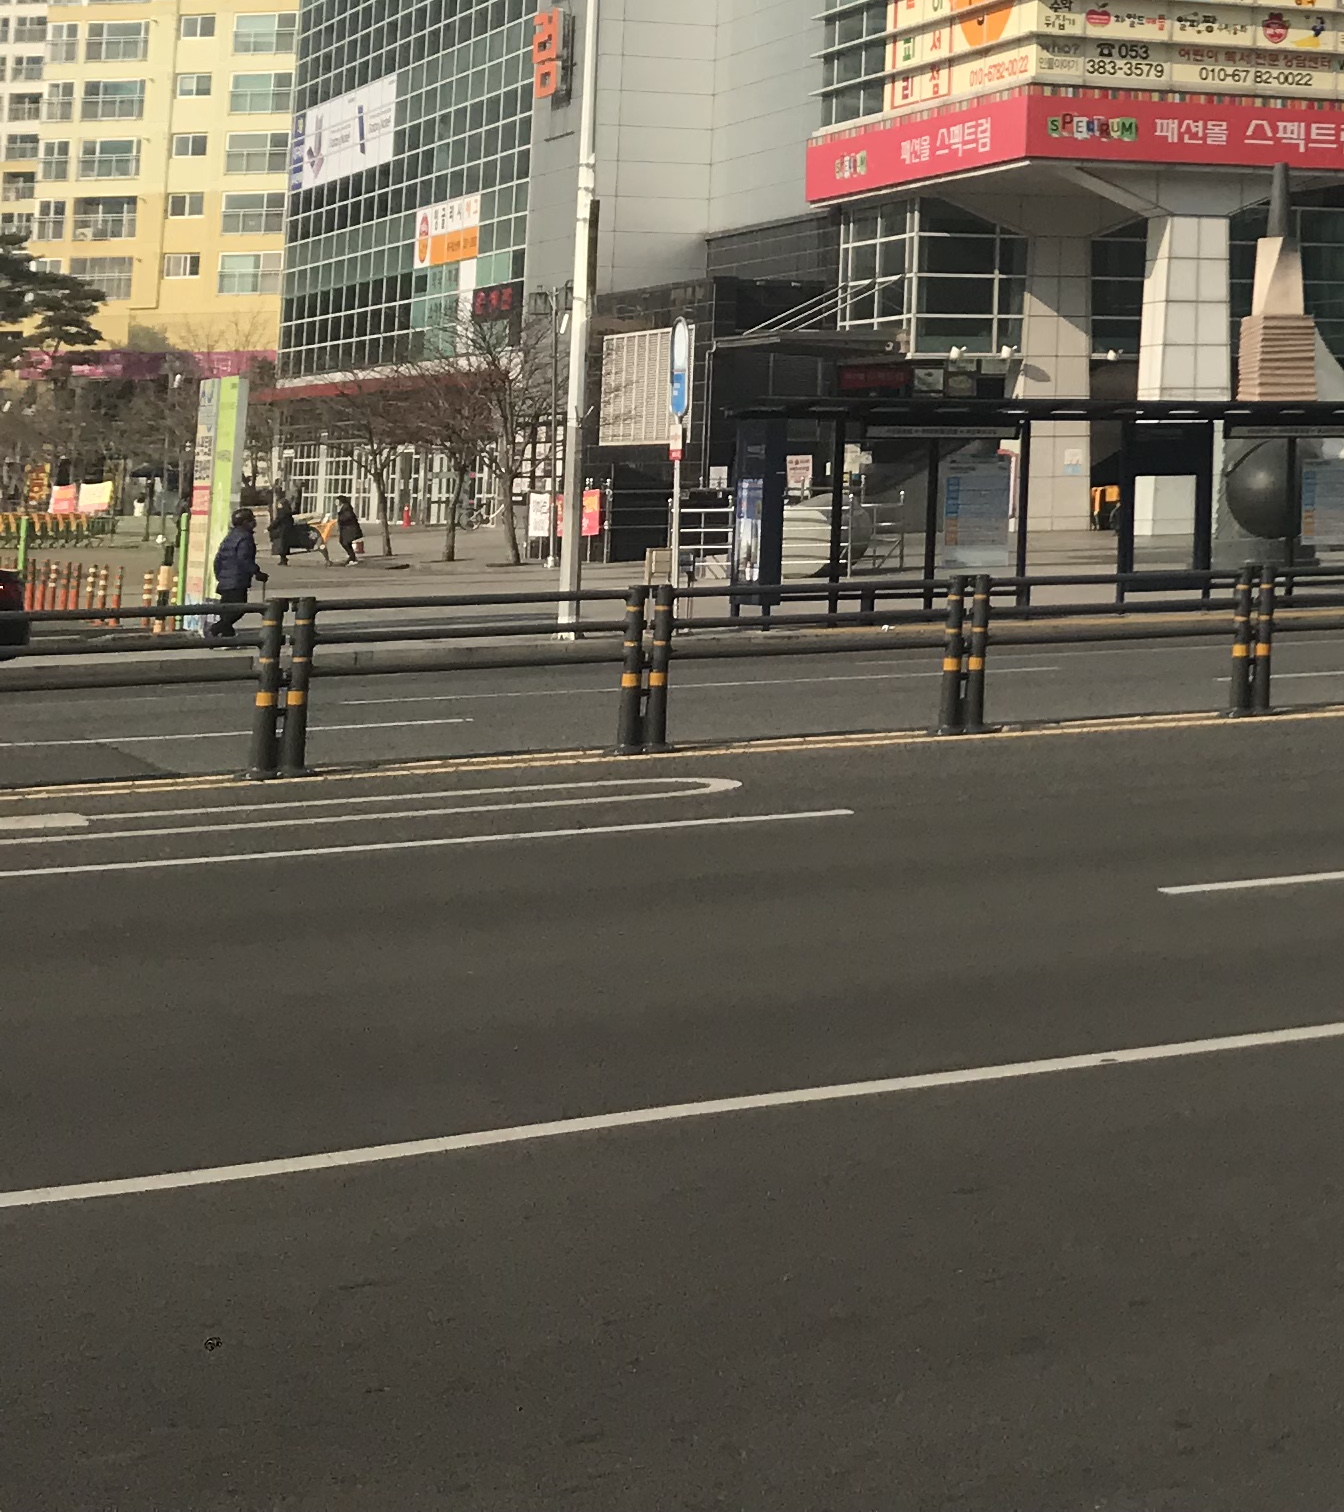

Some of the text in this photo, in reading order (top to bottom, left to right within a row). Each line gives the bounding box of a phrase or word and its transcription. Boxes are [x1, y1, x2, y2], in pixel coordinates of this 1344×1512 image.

[1118, 42, 1150, 59] 053
[1086, 58, 1165, 79] 383-3579
[900, 116, 992, 165] 패션몰 스펙트럼
[1154, 117, 1228, 146] 패션몰
